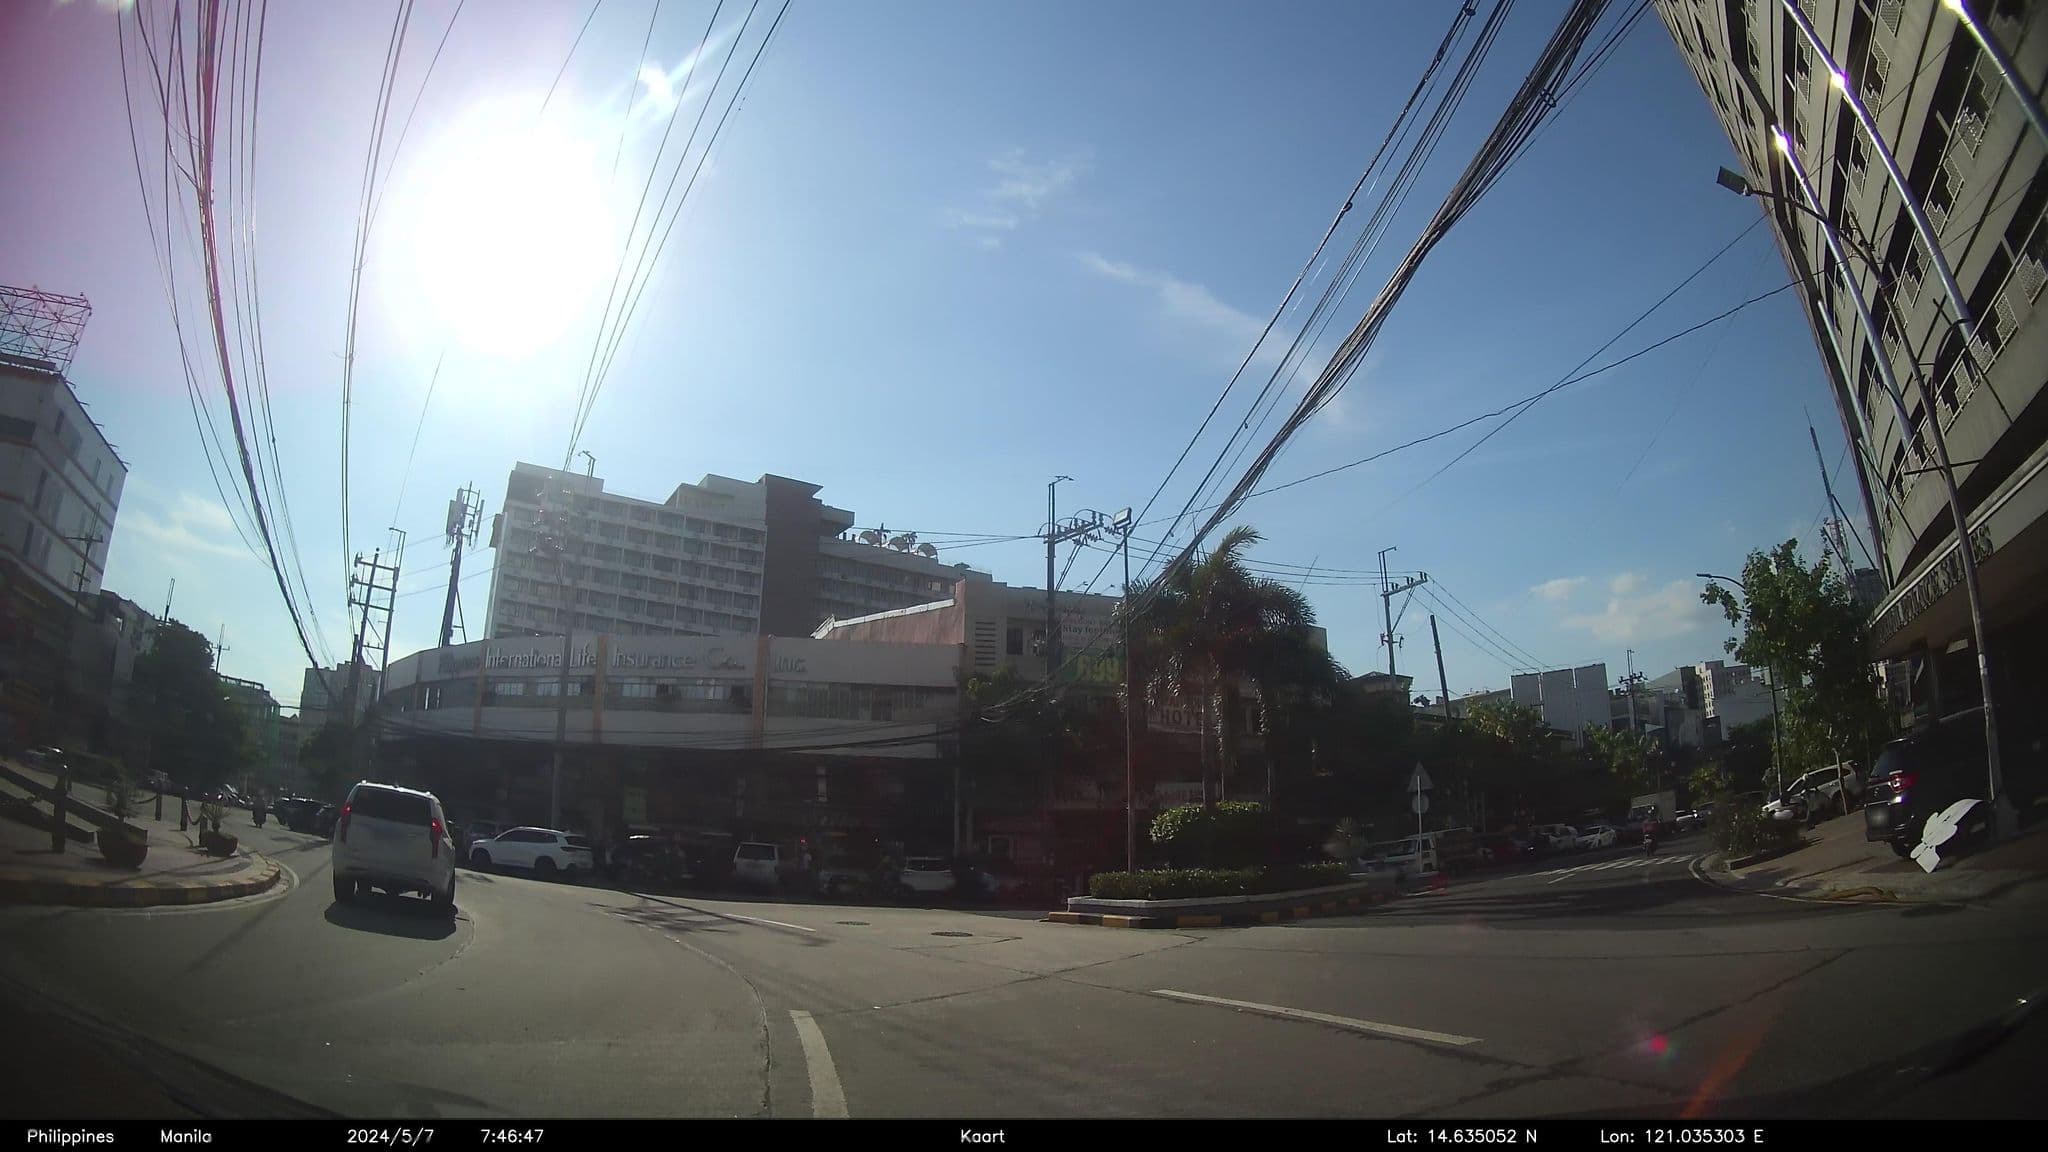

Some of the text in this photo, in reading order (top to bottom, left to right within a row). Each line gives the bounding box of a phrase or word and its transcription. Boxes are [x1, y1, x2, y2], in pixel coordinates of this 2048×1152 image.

[485, 646, 565, 669] International
[569, 643, 597, 668] Life
[612, 645, 696, 669] Insurance
